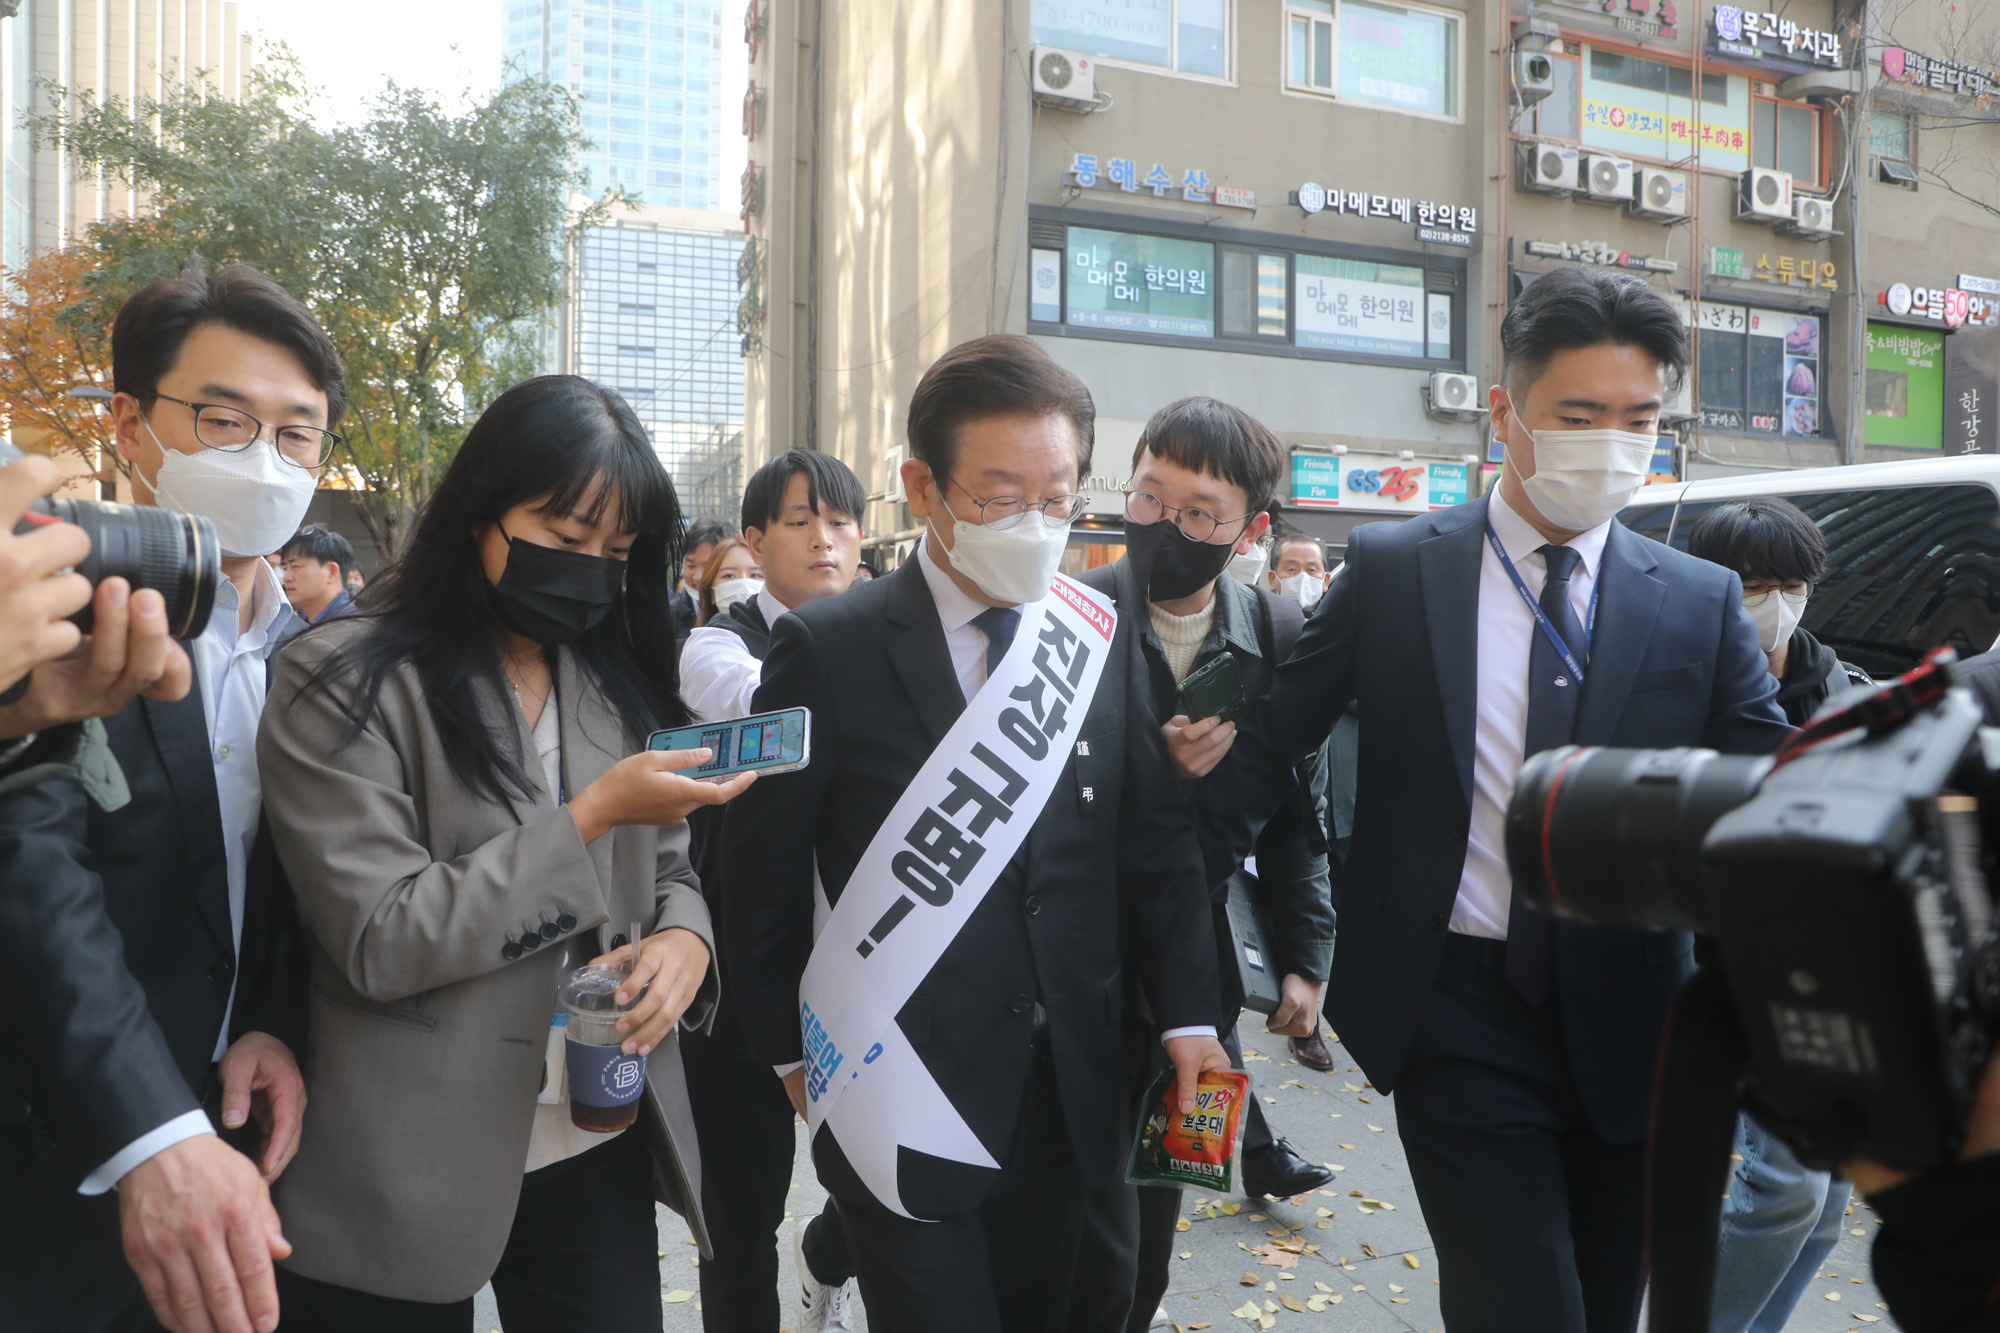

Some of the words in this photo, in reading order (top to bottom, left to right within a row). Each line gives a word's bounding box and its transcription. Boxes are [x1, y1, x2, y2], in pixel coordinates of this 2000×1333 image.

[1742, 11, 1842, 63] 목고박치과
[1071, 153, 1209, 201] 동해수산
[1326, 187, 1411, 224] 마메모메
[1416, 200, 1477, 232] 한의원
[1559, 239, 1620, 265] いざわ
[1143, 265, 1206, 295] 한의원
[1754, 253, 1838, 288] 스튜디오
[1359, 295, 1414, 323] 한의원
[1303, 458, 1335, 472] Friendly
[1433, 466, 1462, 480] Friendly
[1307, 472, 1330, 484] Fresh
[1347, 466, 1426, 502] GS25
[1437, 479, 1458, 490] Fresh
[1310, 486, 1327, 497] Fun
[1440, 493, 1455, 503] Fun
[1076, 740, 1094, 802] 謹弔
[602, 1054, 621, 1073] PARIS
[604, 1077, 643, 1099] BOULANGERIE
[1181, 1114, 1225, 1138] 보온대
